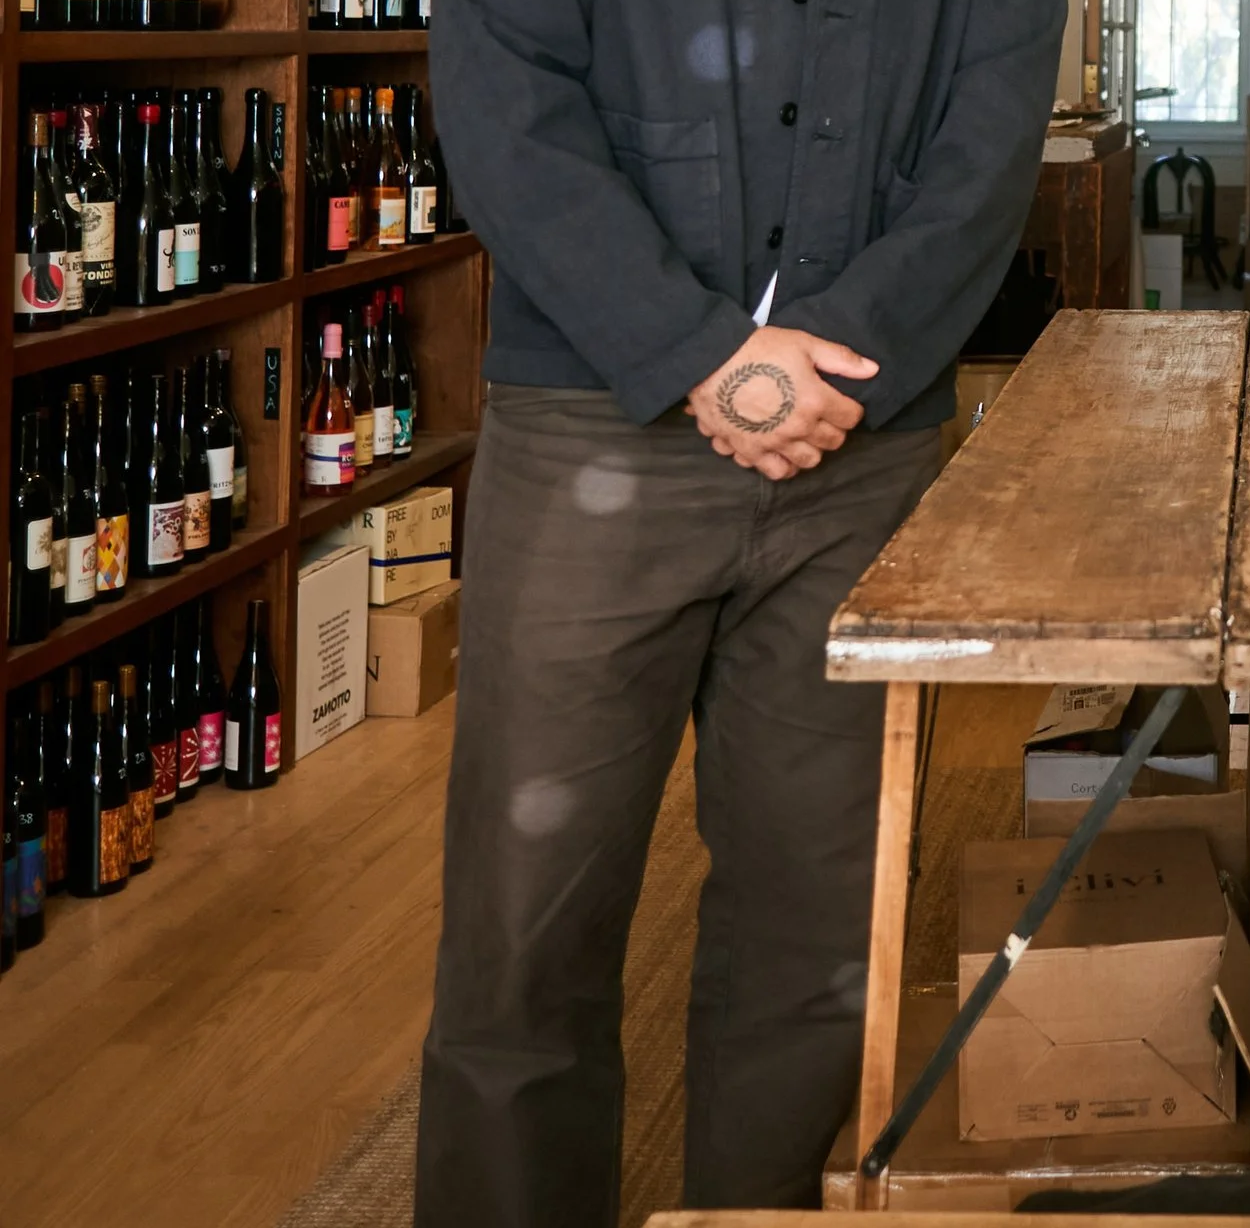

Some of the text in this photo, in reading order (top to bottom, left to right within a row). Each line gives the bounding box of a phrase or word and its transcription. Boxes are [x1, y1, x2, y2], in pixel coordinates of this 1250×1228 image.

[273, 107, 283, 159] SPAIN
[265, 355, 278, 411] USA
[387, 503, 451, 525] FREE DOM
[386, 529, 398, 545] BY
[386, 567, 397, 583] RE
[312, 688, 351, 725] ZANOTTO
[1070, 782, 1101, 795] Cort
[19, 812, 34, 825] 38
